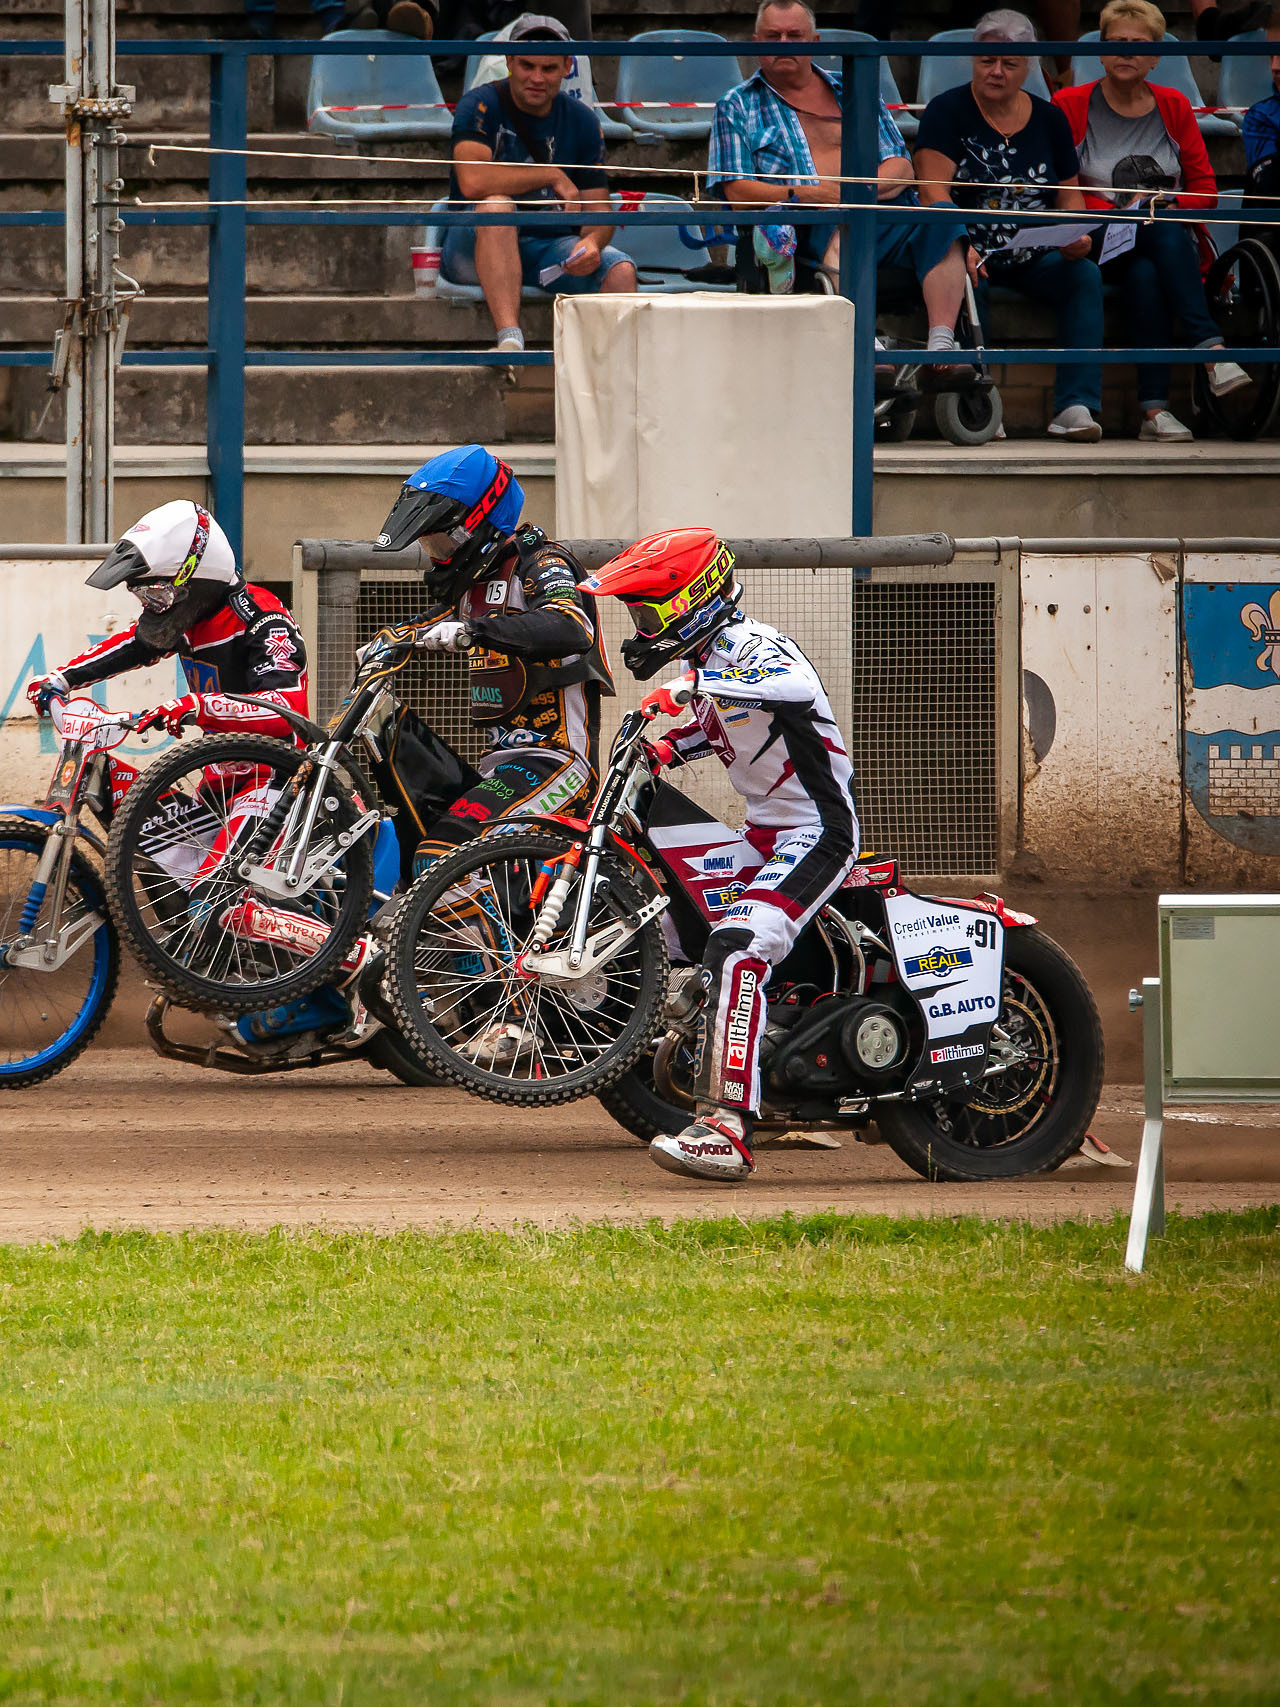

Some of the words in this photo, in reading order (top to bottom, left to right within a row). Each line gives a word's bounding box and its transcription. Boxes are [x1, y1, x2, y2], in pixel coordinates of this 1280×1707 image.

[463, 459, 513, 534] SCO
[688, 548, 736, 597] SCO
[488, 583, 503, 602] 15
[966, 919, 996, 950] #91
[919, 953, 962, 971] REALL
[928, 1003, 956, 1019] G.B.
[958, 996, 996, 1014] AUTO
[728, 970, 756, 1069] althimus
[932, 1045, 984, 1063] althimus
[679, 1141, 734, 1157] daytona
